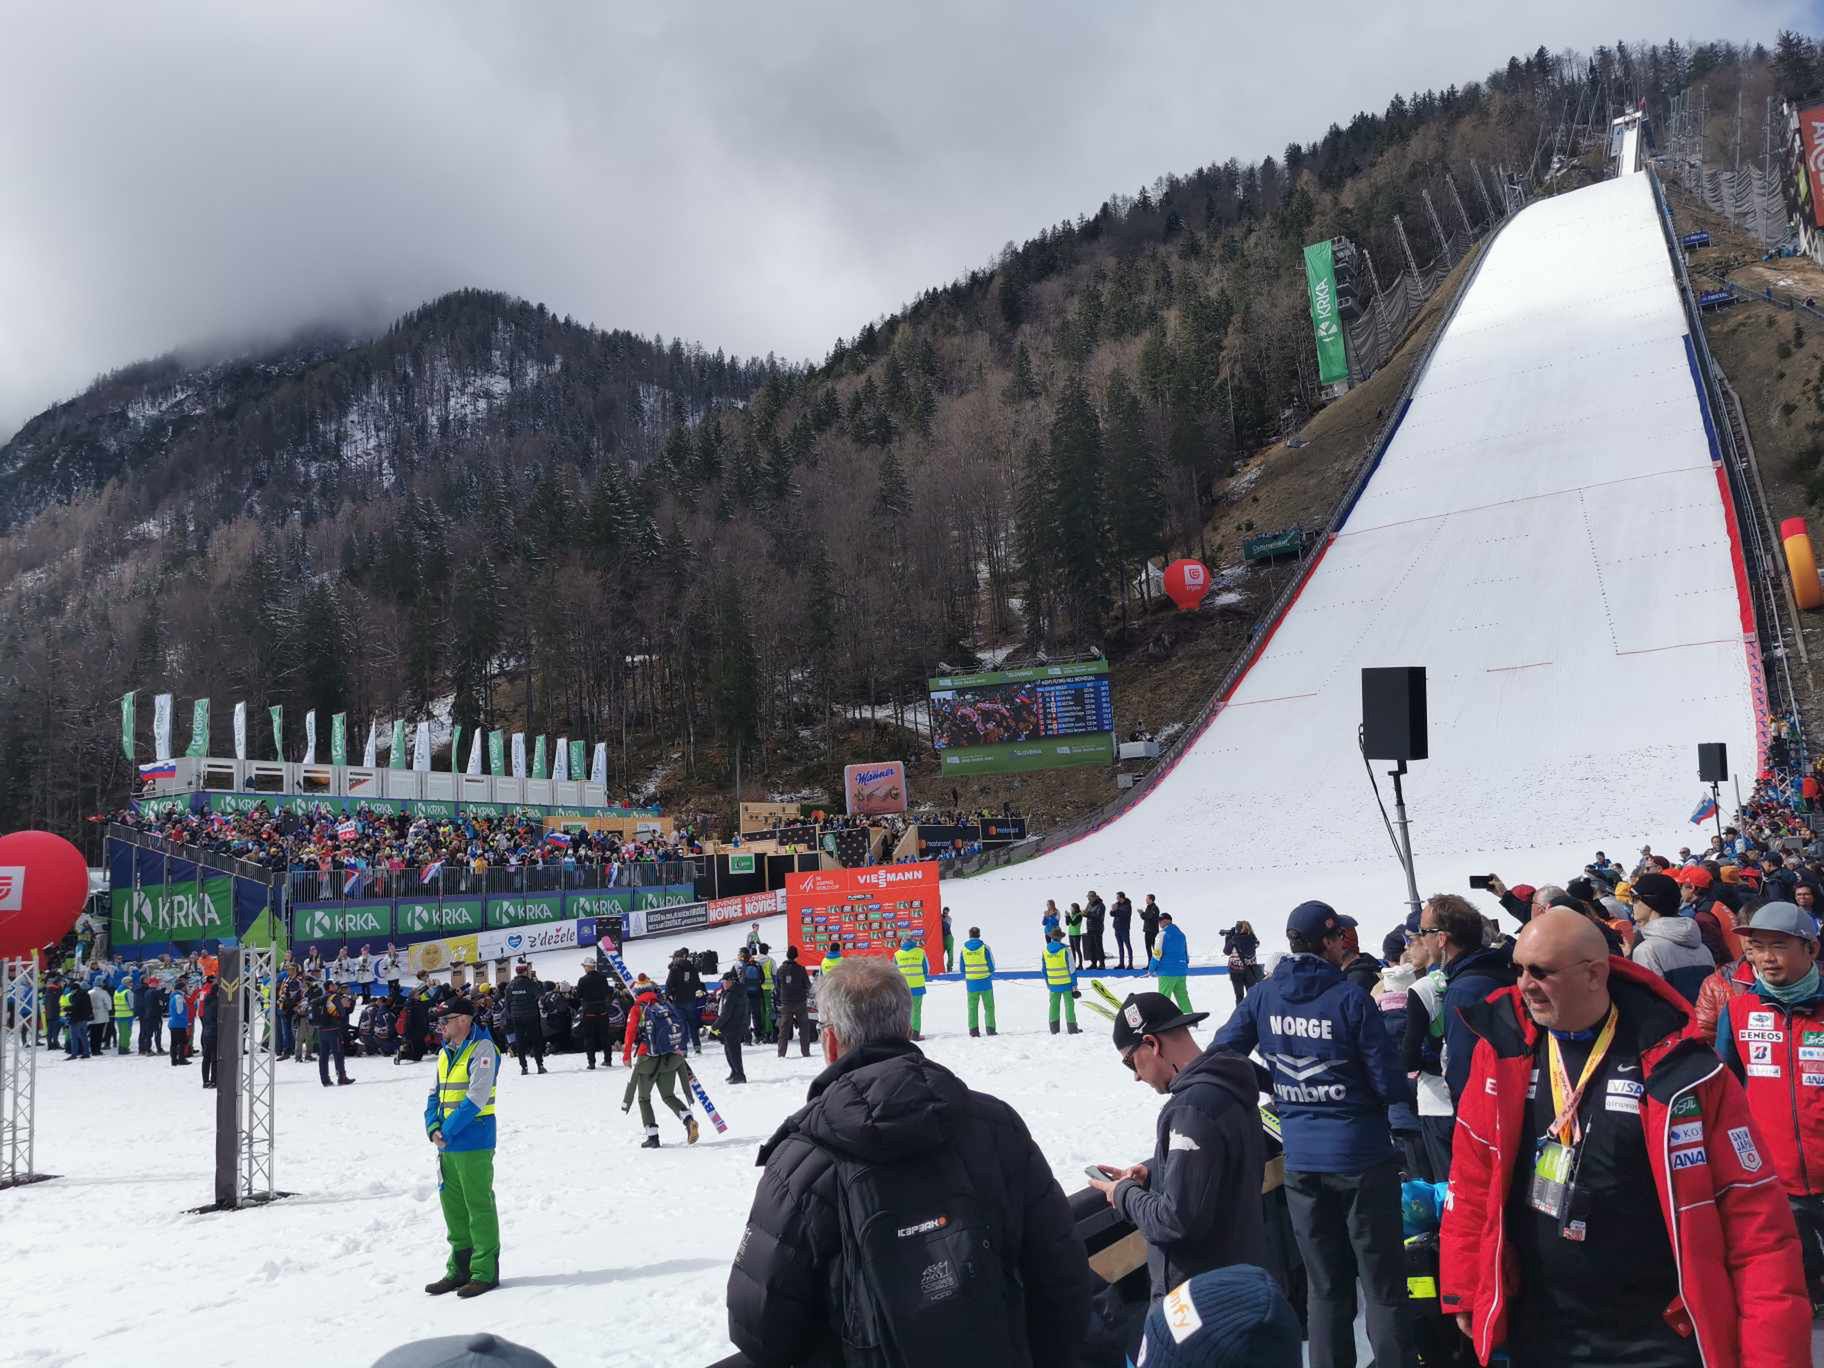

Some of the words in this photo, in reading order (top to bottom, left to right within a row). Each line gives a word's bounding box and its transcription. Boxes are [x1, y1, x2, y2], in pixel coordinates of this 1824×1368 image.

[1315, 277, 1331, 319] KRKA
[855, 767, 896, 786] Manner
[427, 804, 448, 815] KRKA
[857, 870, 923, 888] VIESSMANN
[158, 892, 221, 930] KRKA
[518, 903, 553, 920] KRKA
[593, 898, 624, 915] KRKA
[709, 904, 743, 922] NOVICE
[745, 898, 777, 916] NOVICE
[335, 912, 381, 932] KRKA
[432, 907, 472, 926] KRKA
[609, 951, 632, 982] BWT
[1269, 1015, 1333, 1039] NORGE
[1747, 1031, 1782, 1041] ENEOS
[1612, 1080, 1644, 1094] VISA
[690, 1080, 716, 1115] BWT
[1673, 1150, 1706, 1168] ANA
